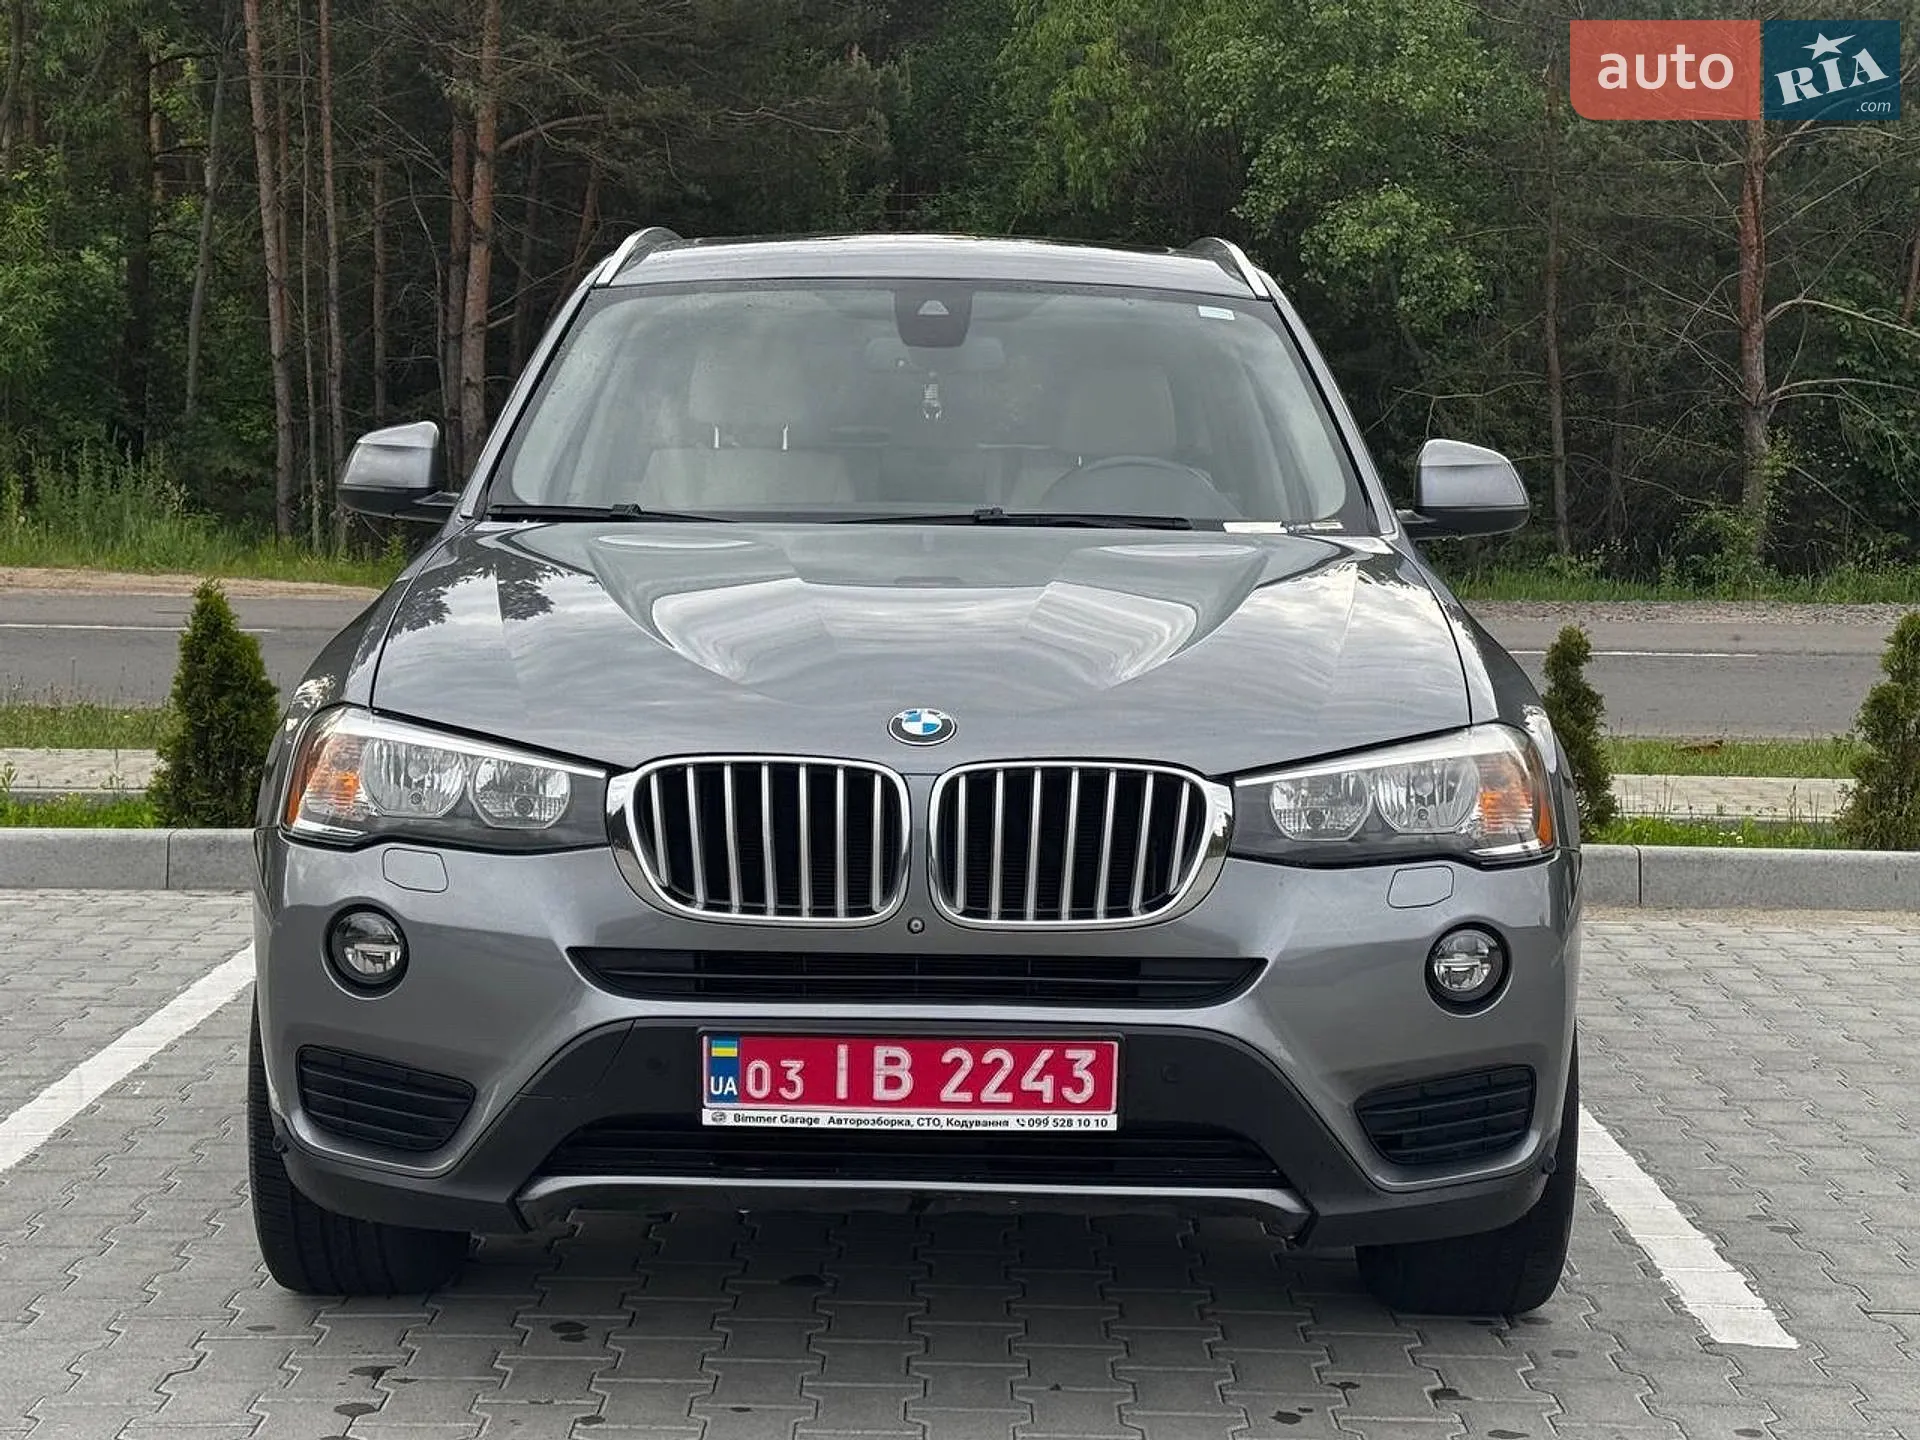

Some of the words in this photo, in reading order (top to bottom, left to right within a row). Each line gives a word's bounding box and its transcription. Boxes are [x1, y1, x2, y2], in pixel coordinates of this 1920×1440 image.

[710, 1076, 738, 1096] UA
[746, 1060, 805, 1100] 03
[940, 1048, 1097, 1104] 2243
[733, 1112, 777, 1124] Bimmer
[780, 1114, 820, 1126] Garage
[827, 1115, 914, 1128] Авторозборка,
[916, 1117, 943, 1129] СТО,
[946, 1117, 1009, 1129] Кодування
[1027, 1117, 1050, 1128] 099
[1052, 1117, 1074, 1128] 528
[1077, 1117, 1091, 1128] 10
[1094, 1117, 1108, 1129] 10
